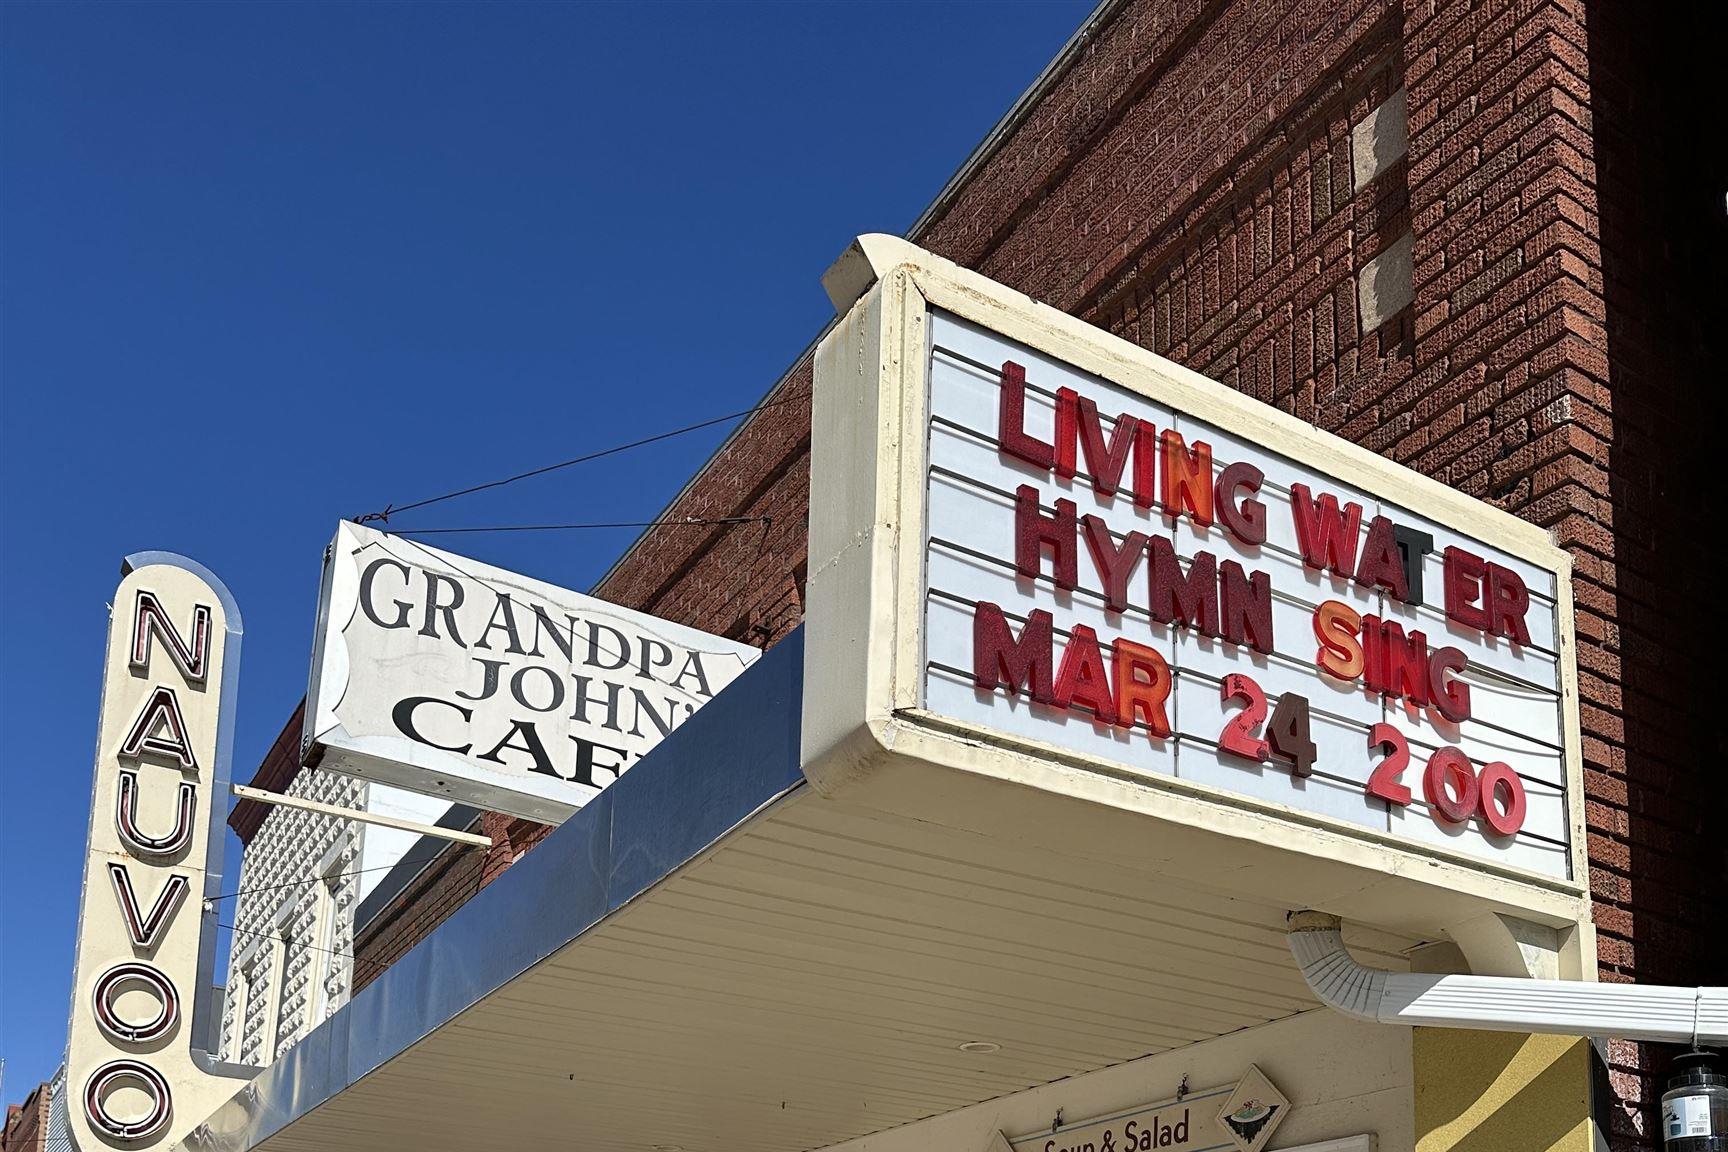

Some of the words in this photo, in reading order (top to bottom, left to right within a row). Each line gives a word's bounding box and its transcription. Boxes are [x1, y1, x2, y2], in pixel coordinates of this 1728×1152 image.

[999, 361, 1266, 545] LIVING
[1291, 482, 1530, 646] WATER
[1015, 484, 1274, 654] HYMN
[1312, 599, 1471, 723] SING
[359, 558, 713, 697] GRANDPA
[392, 696, 646, 790] CAF
[974, 600, 1171, 738] MAR
[1219, 673, 1317, 778] 24
[1366, 723, 1526, 836] 200
[83, 589, 212, 1140] NAUVOO
